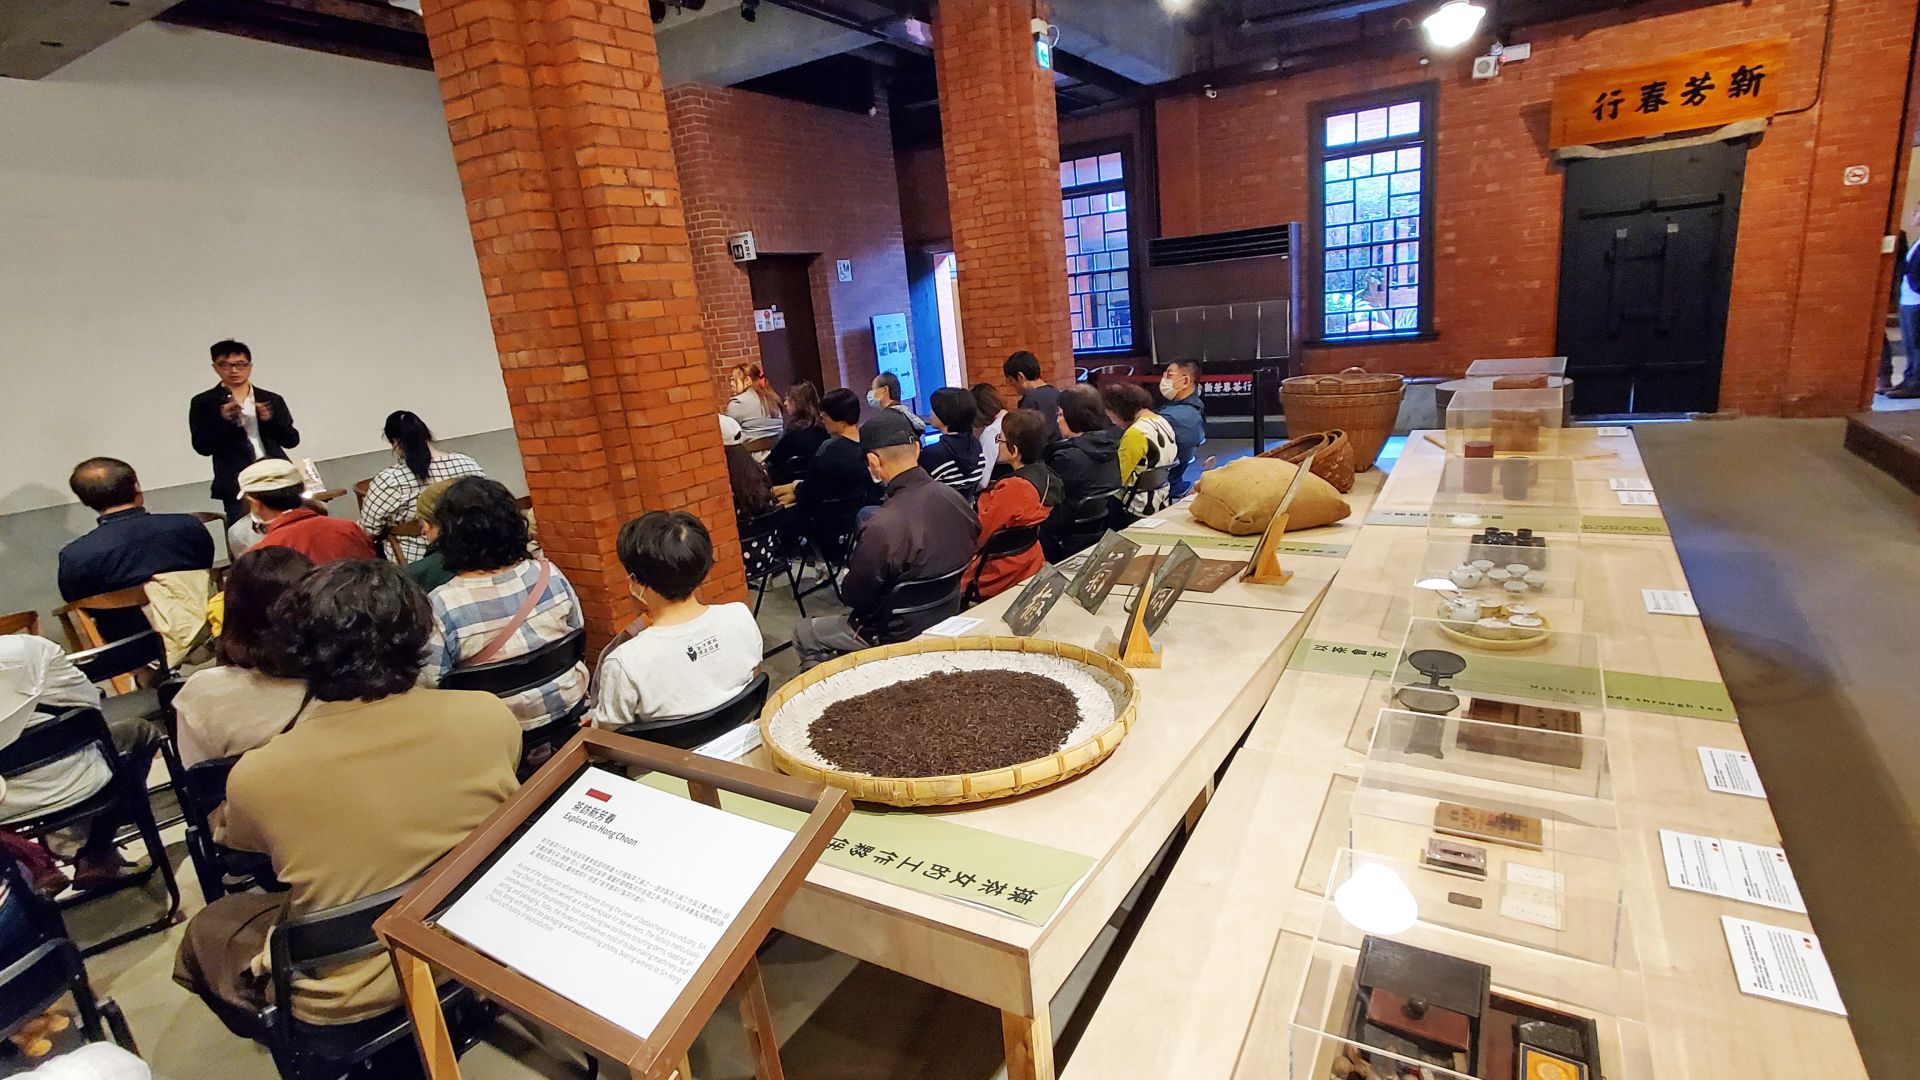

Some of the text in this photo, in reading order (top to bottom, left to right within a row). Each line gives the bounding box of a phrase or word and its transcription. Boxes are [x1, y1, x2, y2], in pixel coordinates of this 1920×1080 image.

[1592, 64, 1767, 121] 新芳春行
[1312, 643, 1389, 659] 以茶會友
[563, 812, 639, 847] Explore Sin Hong Choon
